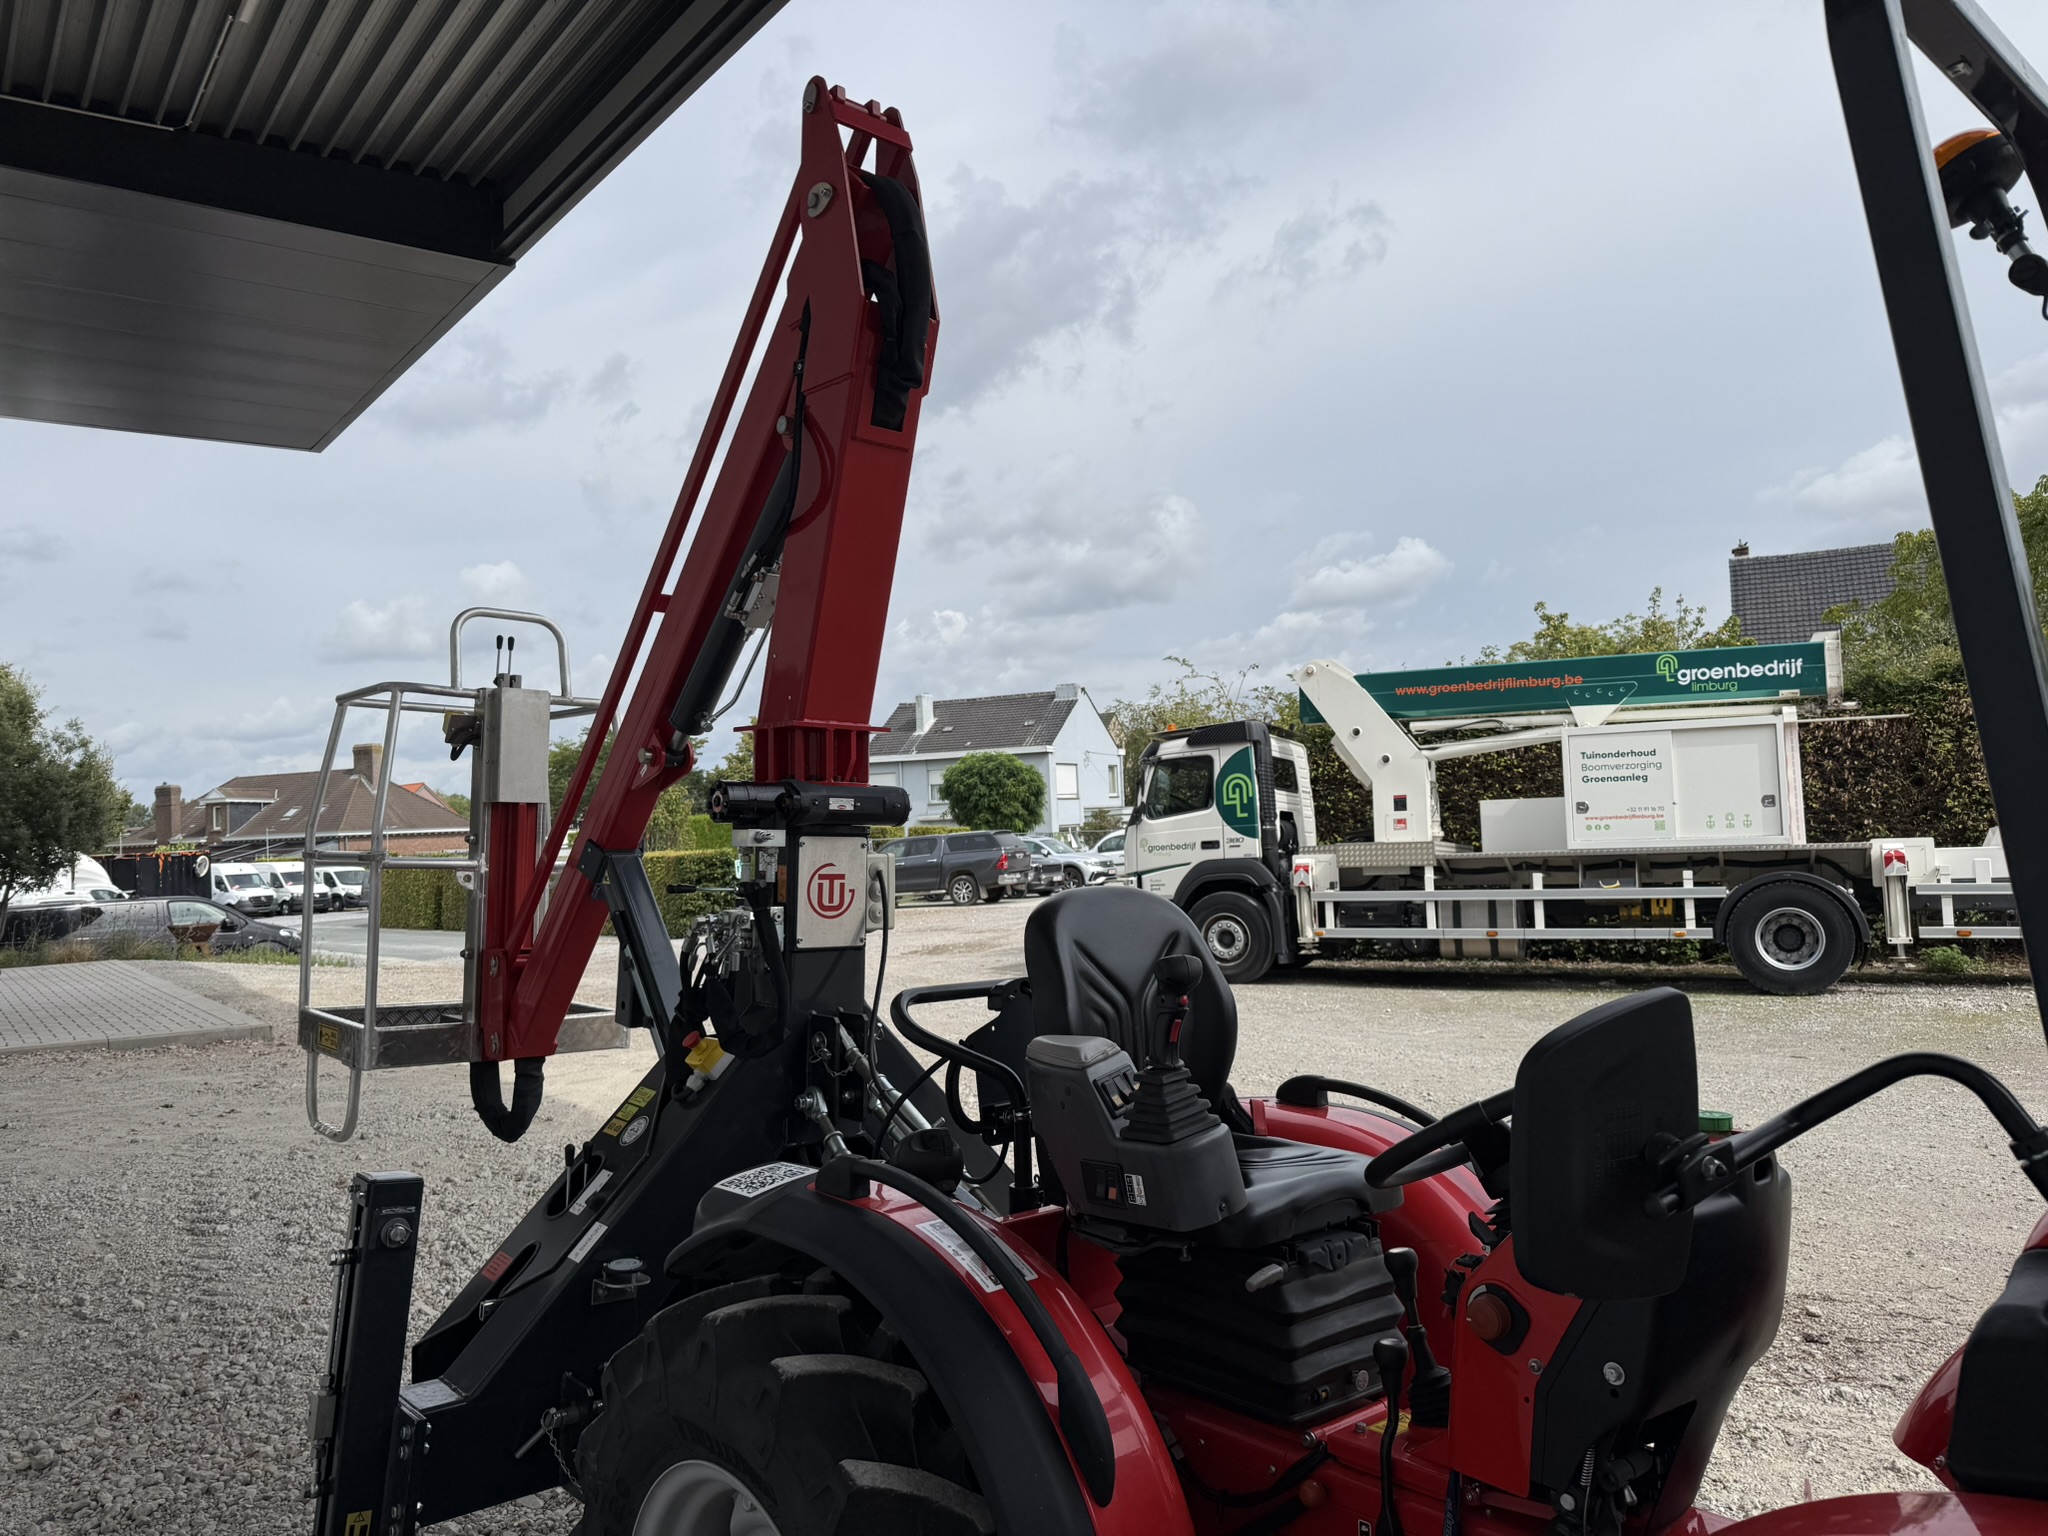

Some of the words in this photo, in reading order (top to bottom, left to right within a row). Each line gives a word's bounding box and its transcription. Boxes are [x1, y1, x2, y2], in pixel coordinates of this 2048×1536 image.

[1677, 658, 1803, 685] groenbedrijf
[1395, 674, 1583, 696] www.groenbedrijflimburg.be
[1691, 680, 1738, 692] limburg
[1580, 748, 1656, 760] Tuinonderhoud
[1581, 760, 1662, 772] Boomverzorging
[1581, 773, 1648, 784] Groenaanleg
[1147, 842, 1196, 853] groenbedrijf
